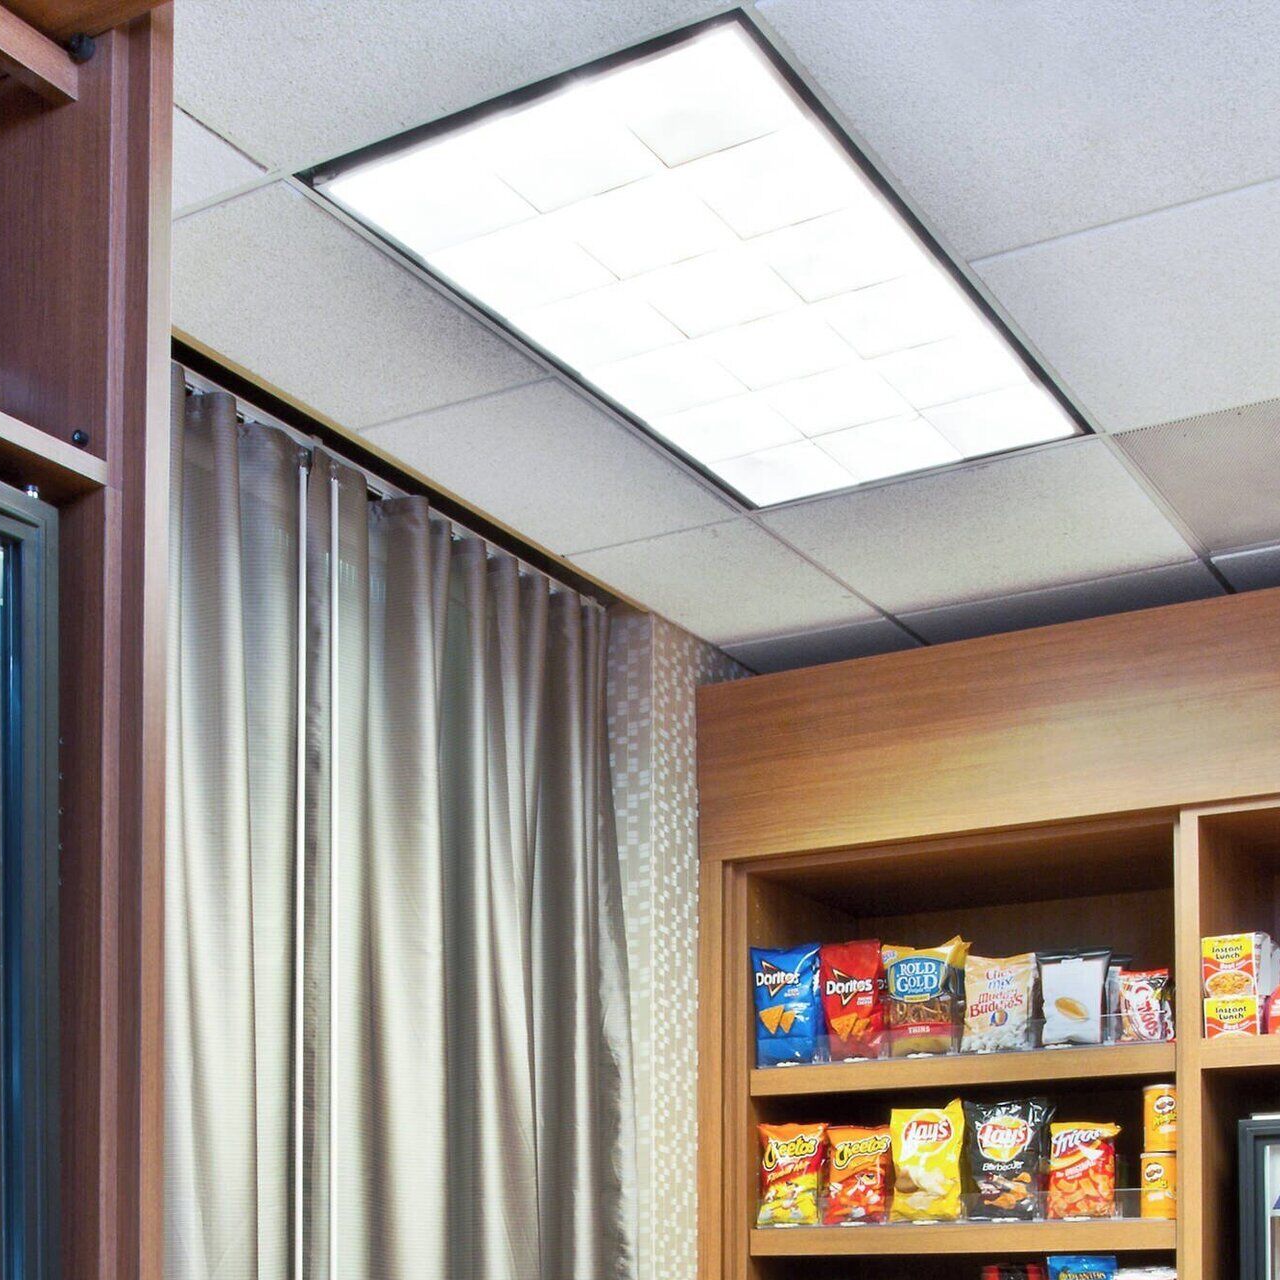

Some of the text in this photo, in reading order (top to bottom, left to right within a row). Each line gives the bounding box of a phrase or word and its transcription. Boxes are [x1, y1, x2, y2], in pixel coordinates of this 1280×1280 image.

[1211, 945, 1243, 954] Instant
[1215, 953, 1241, 961] Lunch
[756, 971, 800, 987] Doritos
[826, 978, 873, 996] Doritos
[896, 974, 938, 992] GOLD
[1215, 1006, 1247, 1014] Instant
[1219, 1012, 1245, 1021] Lunch
[1052, 1128, 1101, 1159] Fritos
[834, 1135, 891, 1170] Cheetos
